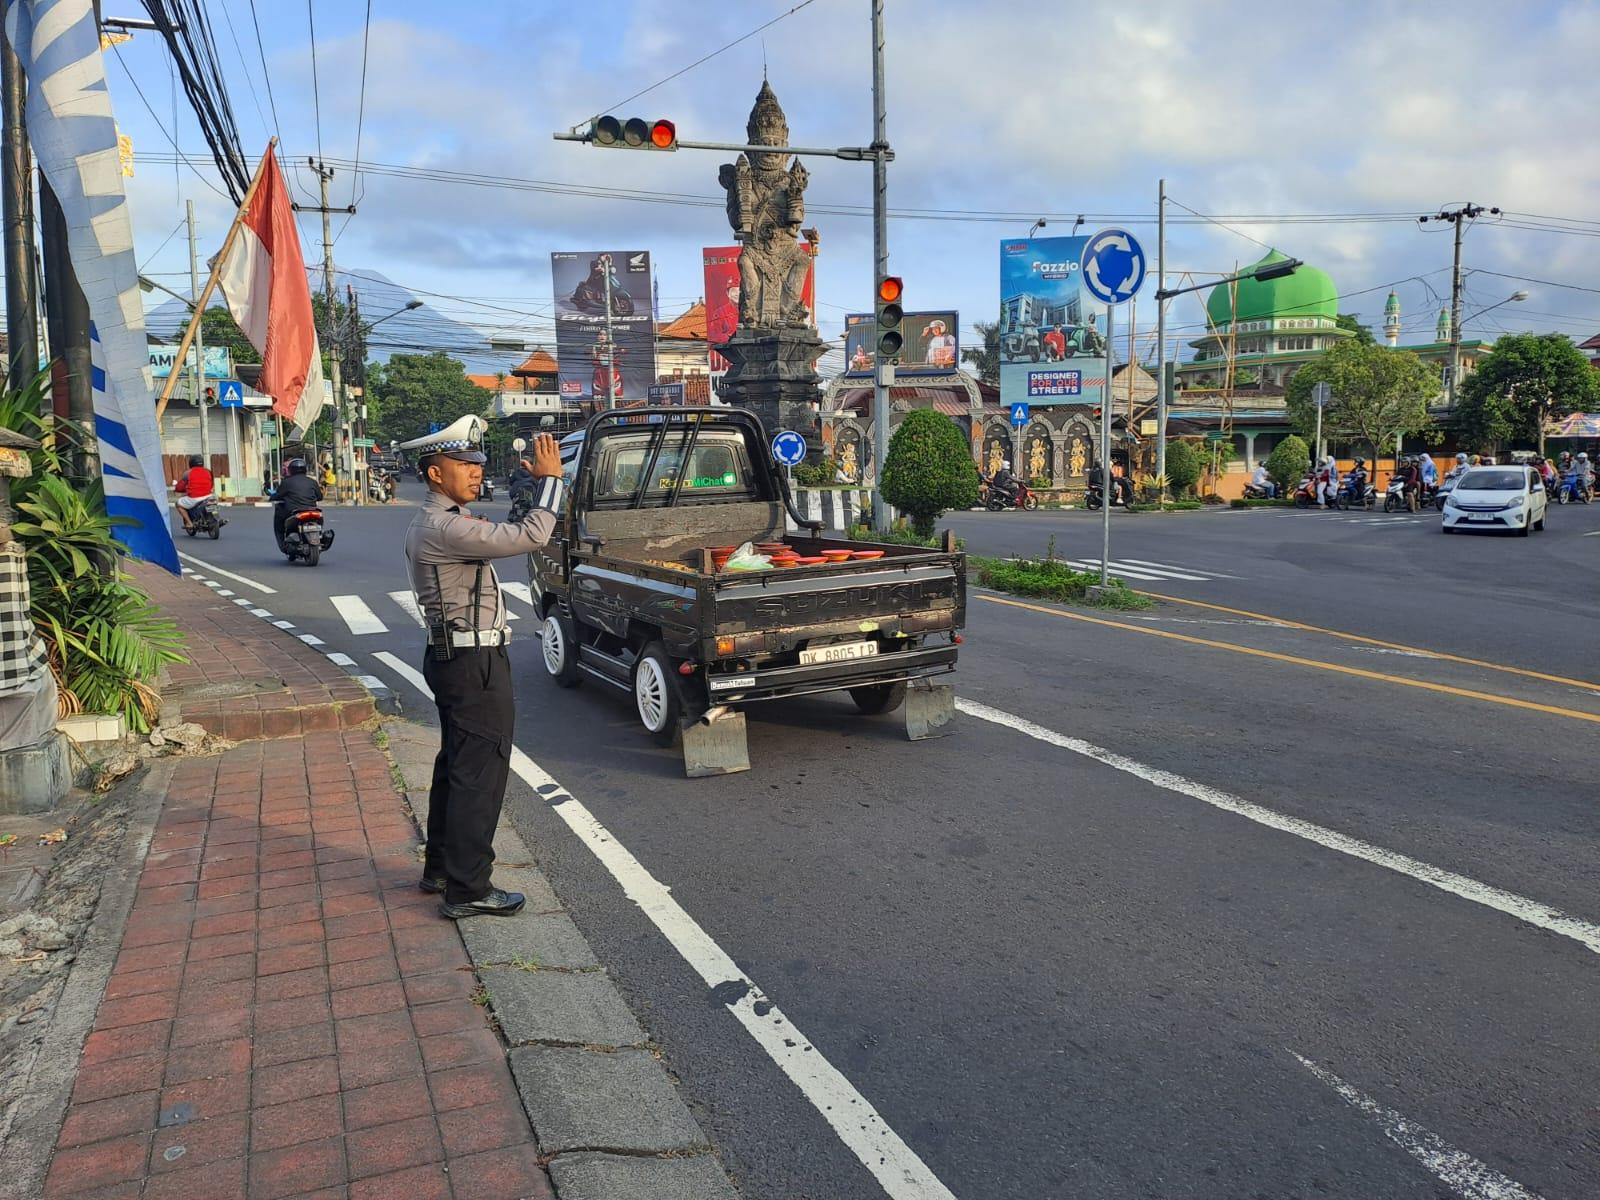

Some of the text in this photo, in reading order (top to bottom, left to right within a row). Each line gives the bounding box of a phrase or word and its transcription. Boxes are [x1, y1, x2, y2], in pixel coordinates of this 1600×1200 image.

[1033, 260, 1079, 272] Fazzio
[1031, 372, 1079, 380] DESIGNED
[1032, 386, 1078, 394] STREETS
[693, 476, 725, 488] MiChat
[755, 583, 922, 618] SUZUKI
[802, 651, 817, 665] DK
[825, 647, 857, 662] 8805
